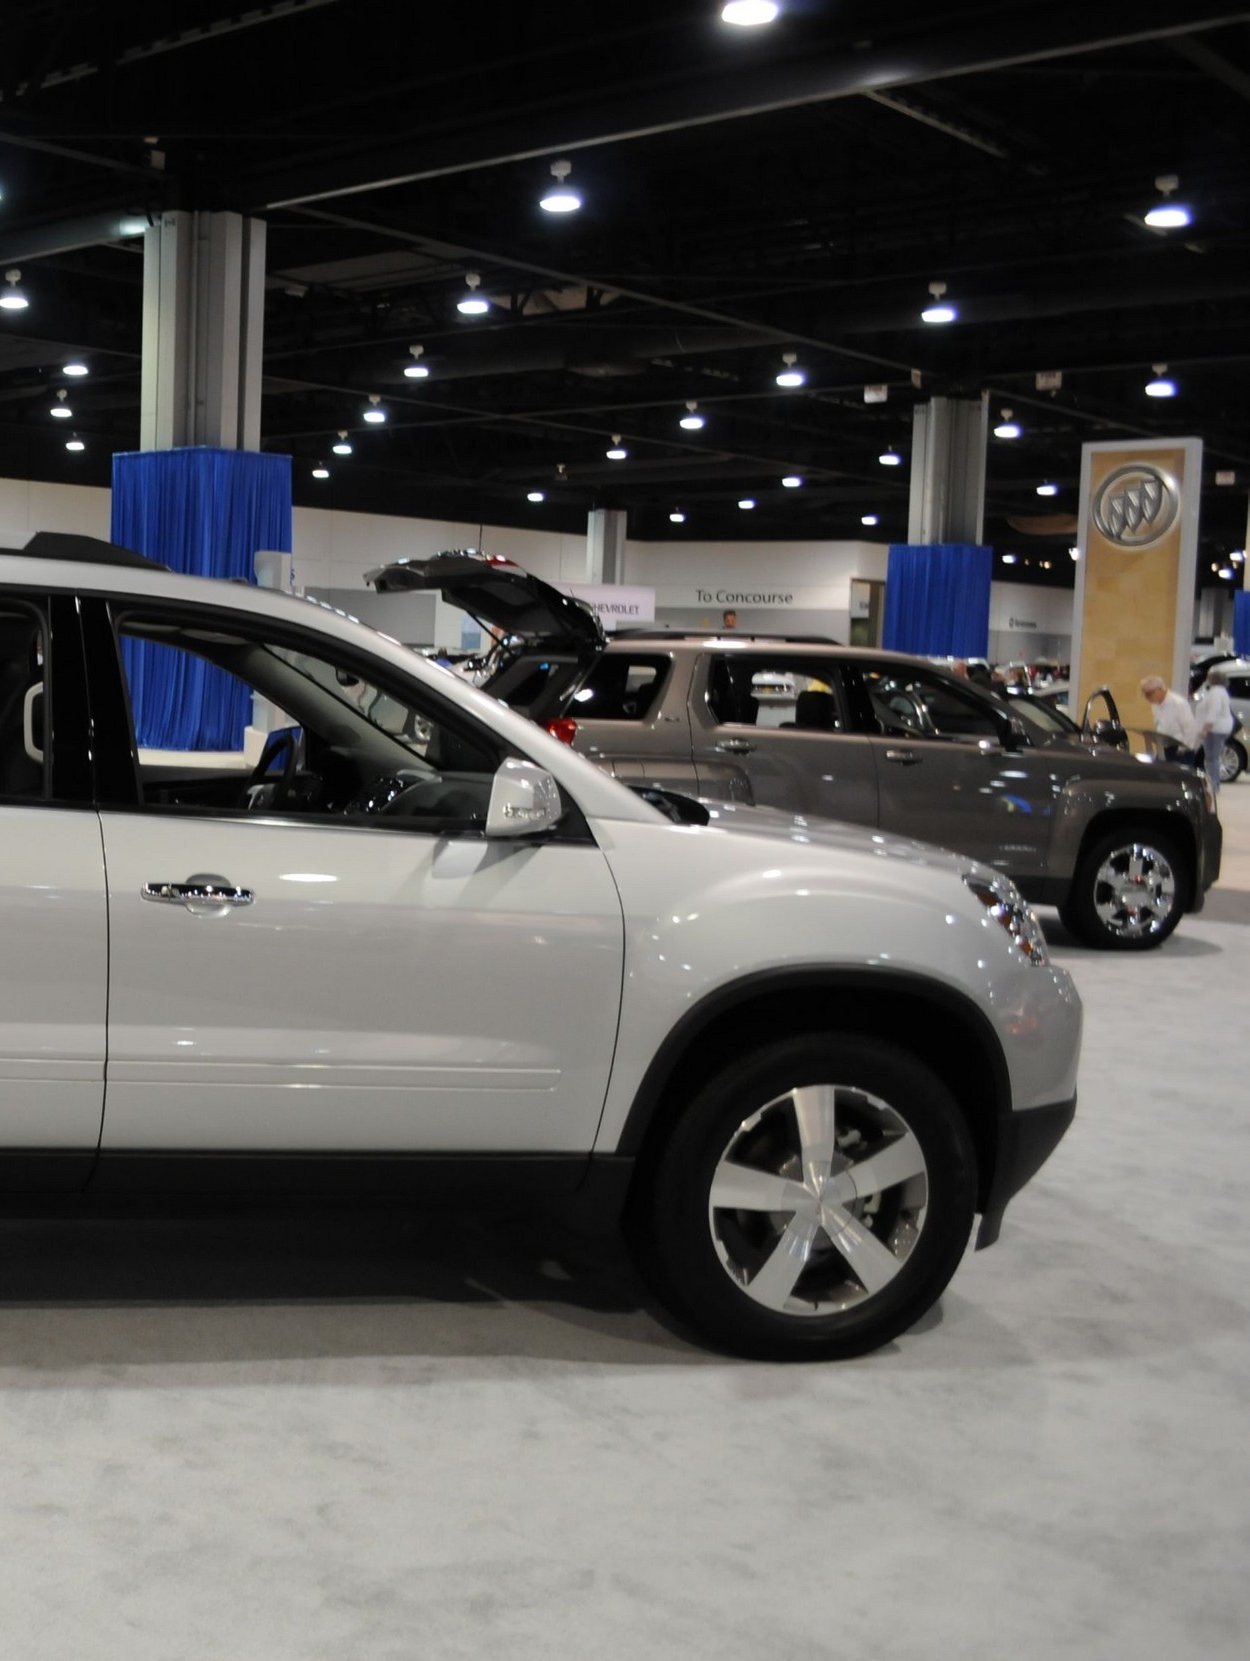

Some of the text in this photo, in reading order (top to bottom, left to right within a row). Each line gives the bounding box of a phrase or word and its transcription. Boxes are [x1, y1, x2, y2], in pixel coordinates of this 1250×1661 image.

[695, 588, 793, 604] To Concourse
[591, 602, 639, 615] HEVROLET
